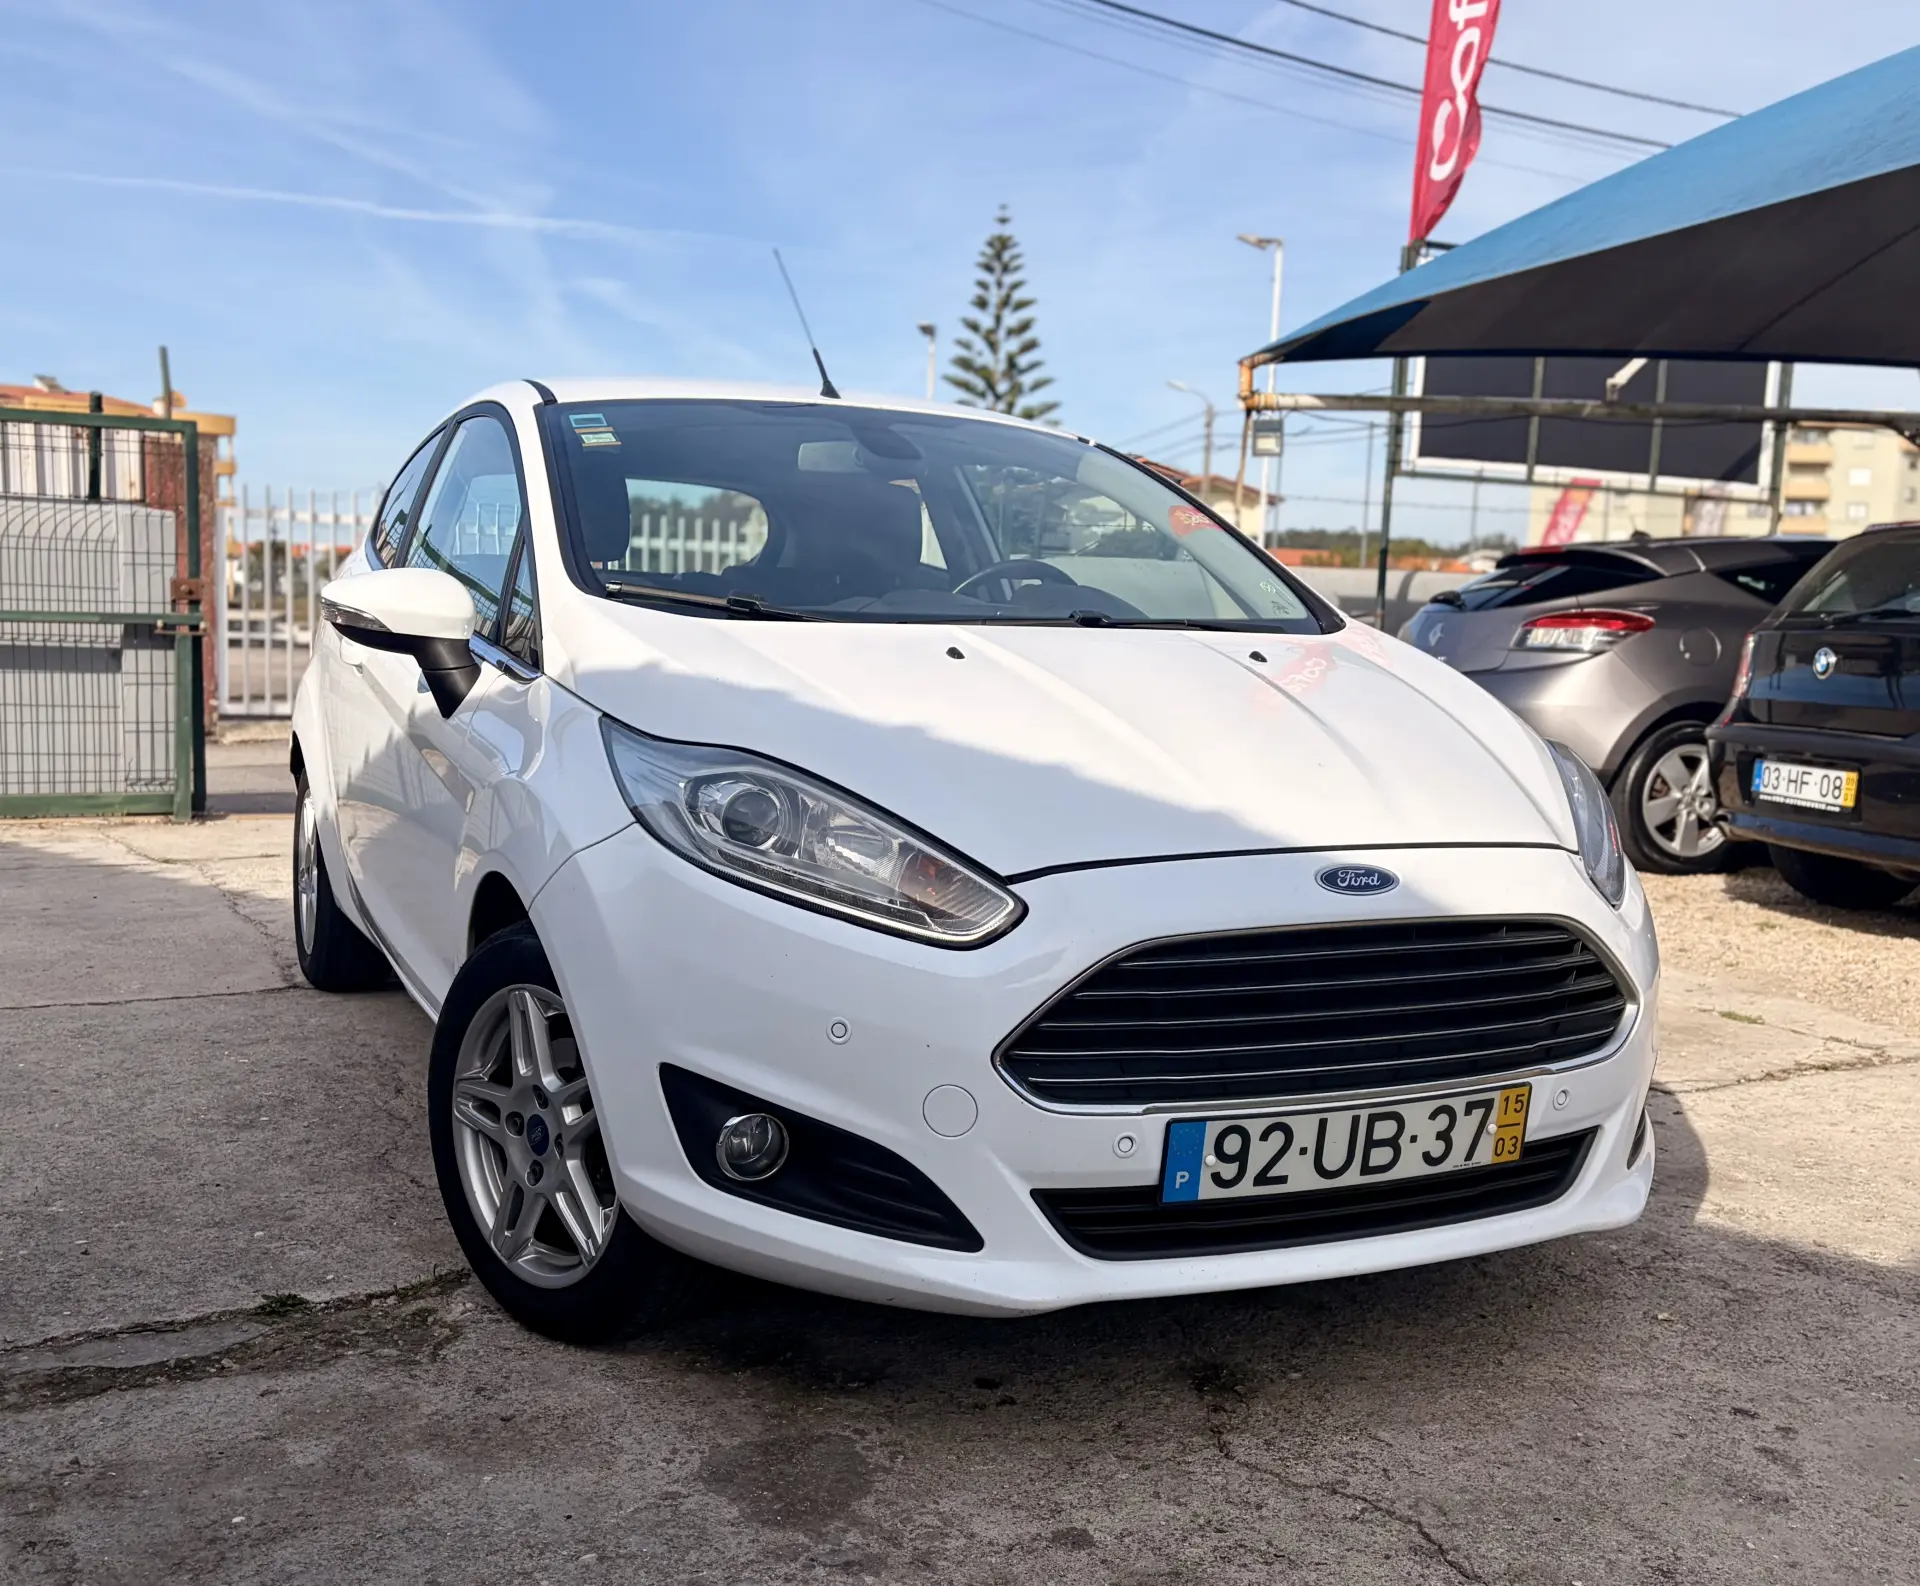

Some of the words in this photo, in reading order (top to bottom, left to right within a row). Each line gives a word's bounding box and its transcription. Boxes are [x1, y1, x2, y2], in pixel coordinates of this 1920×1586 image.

[1337, 869, 1382, 887] Ford
[1503, 1093, 1526, 1116] 15
[1494, 1135, 1519, 1157] 03
[1174, 1170, 1190, 1189] P
